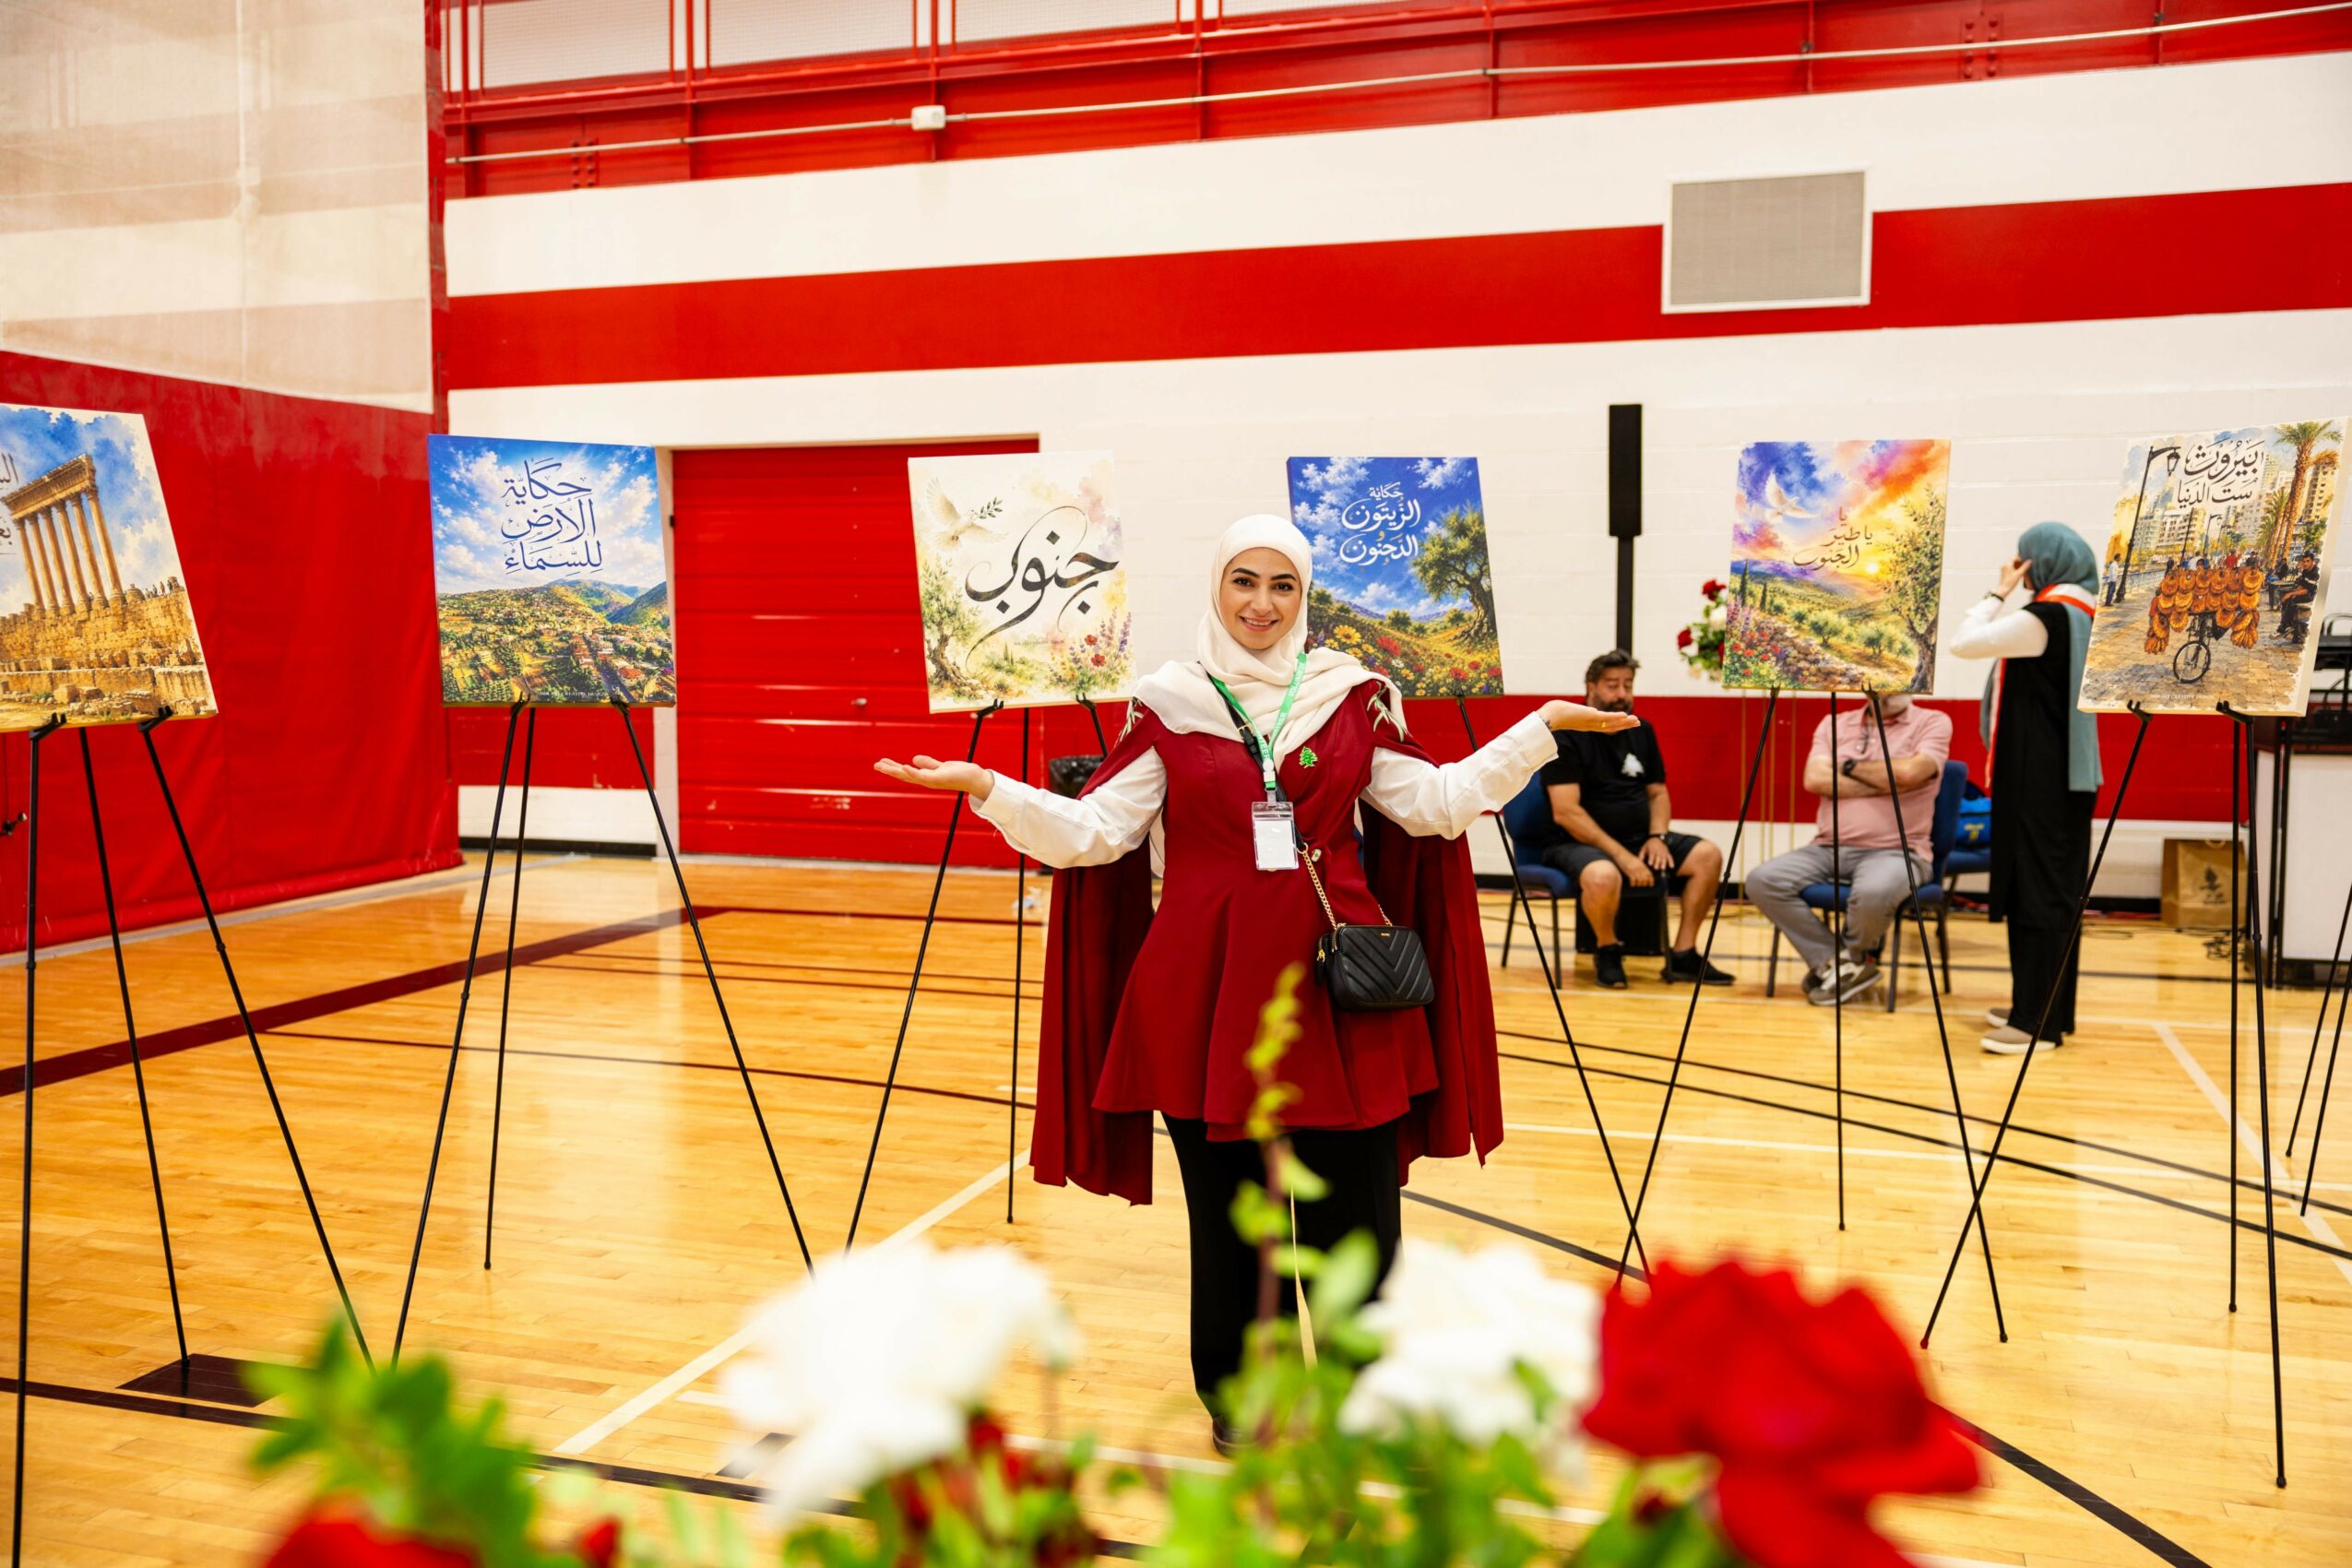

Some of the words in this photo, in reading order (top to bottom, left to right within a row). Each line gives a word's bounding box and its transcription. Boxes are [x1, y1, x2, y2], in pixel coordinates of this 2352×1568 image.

[2178, 480, 2210, 509] الدنيا
[1341, 498, 1420, 532] الزيتون
[1838, 505, 1847, 527] يا
[1864, 525, 1873, 545] يا
[1793, 544, 1859, 571] الجنوب
[964, 506, 1120, 671] جنوب
